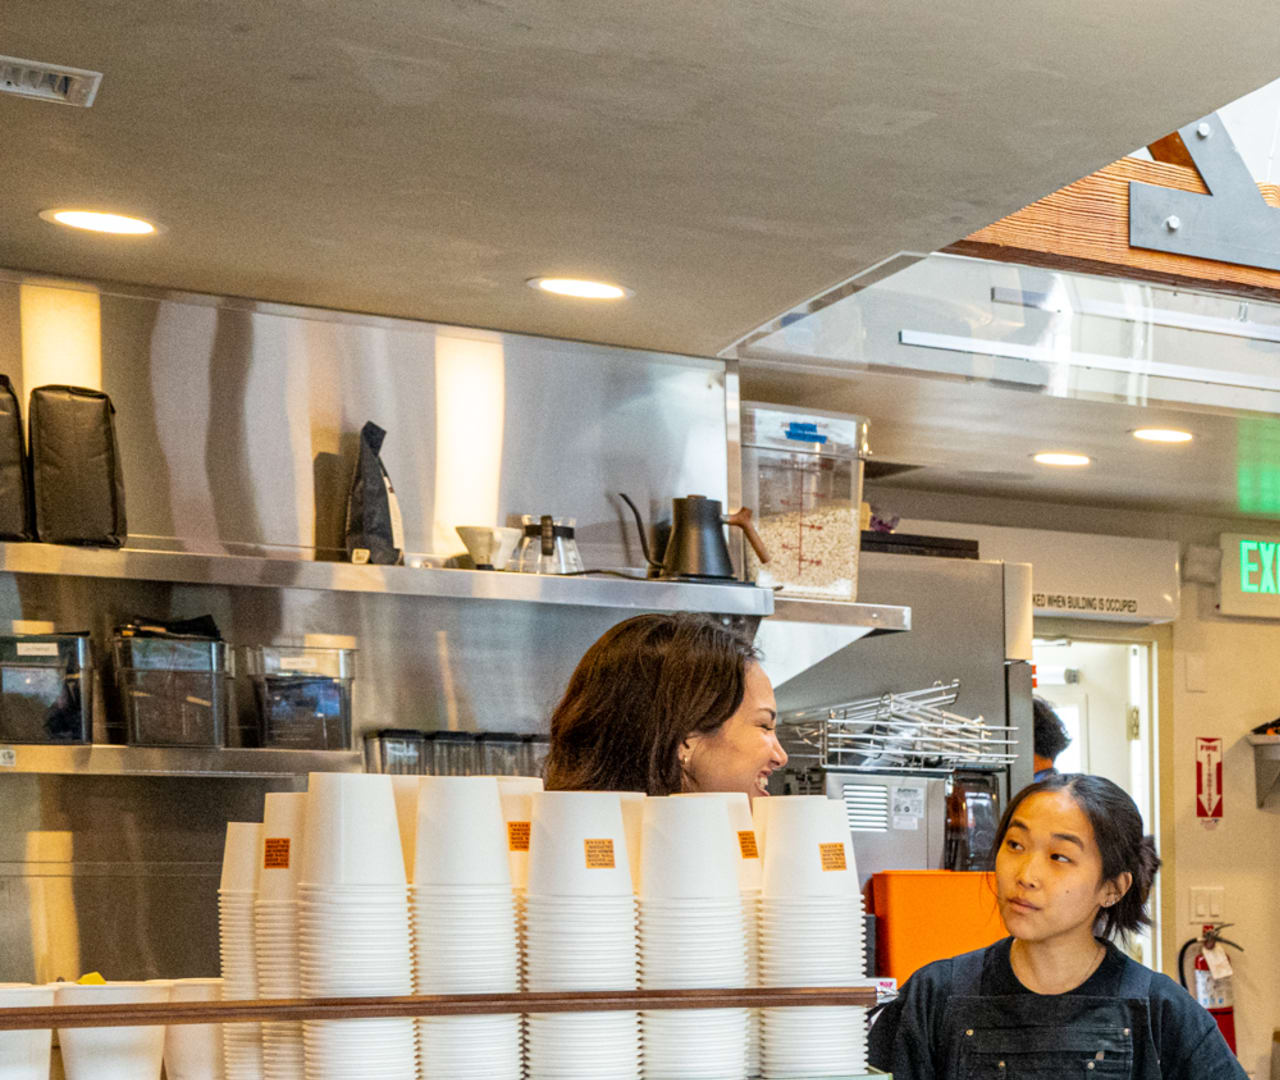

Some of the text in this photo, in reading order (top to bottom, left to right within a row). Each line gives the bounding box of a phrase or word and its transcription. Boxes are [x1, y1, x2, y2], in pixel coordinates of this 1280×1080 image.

[1047, 594, 1066, 608] WHEN
[1067, 595, 1097, 610] BUILDING
[1099, 597, 1105, 611] IS
[1106, 598, 1137, 613] OCCUPIED
